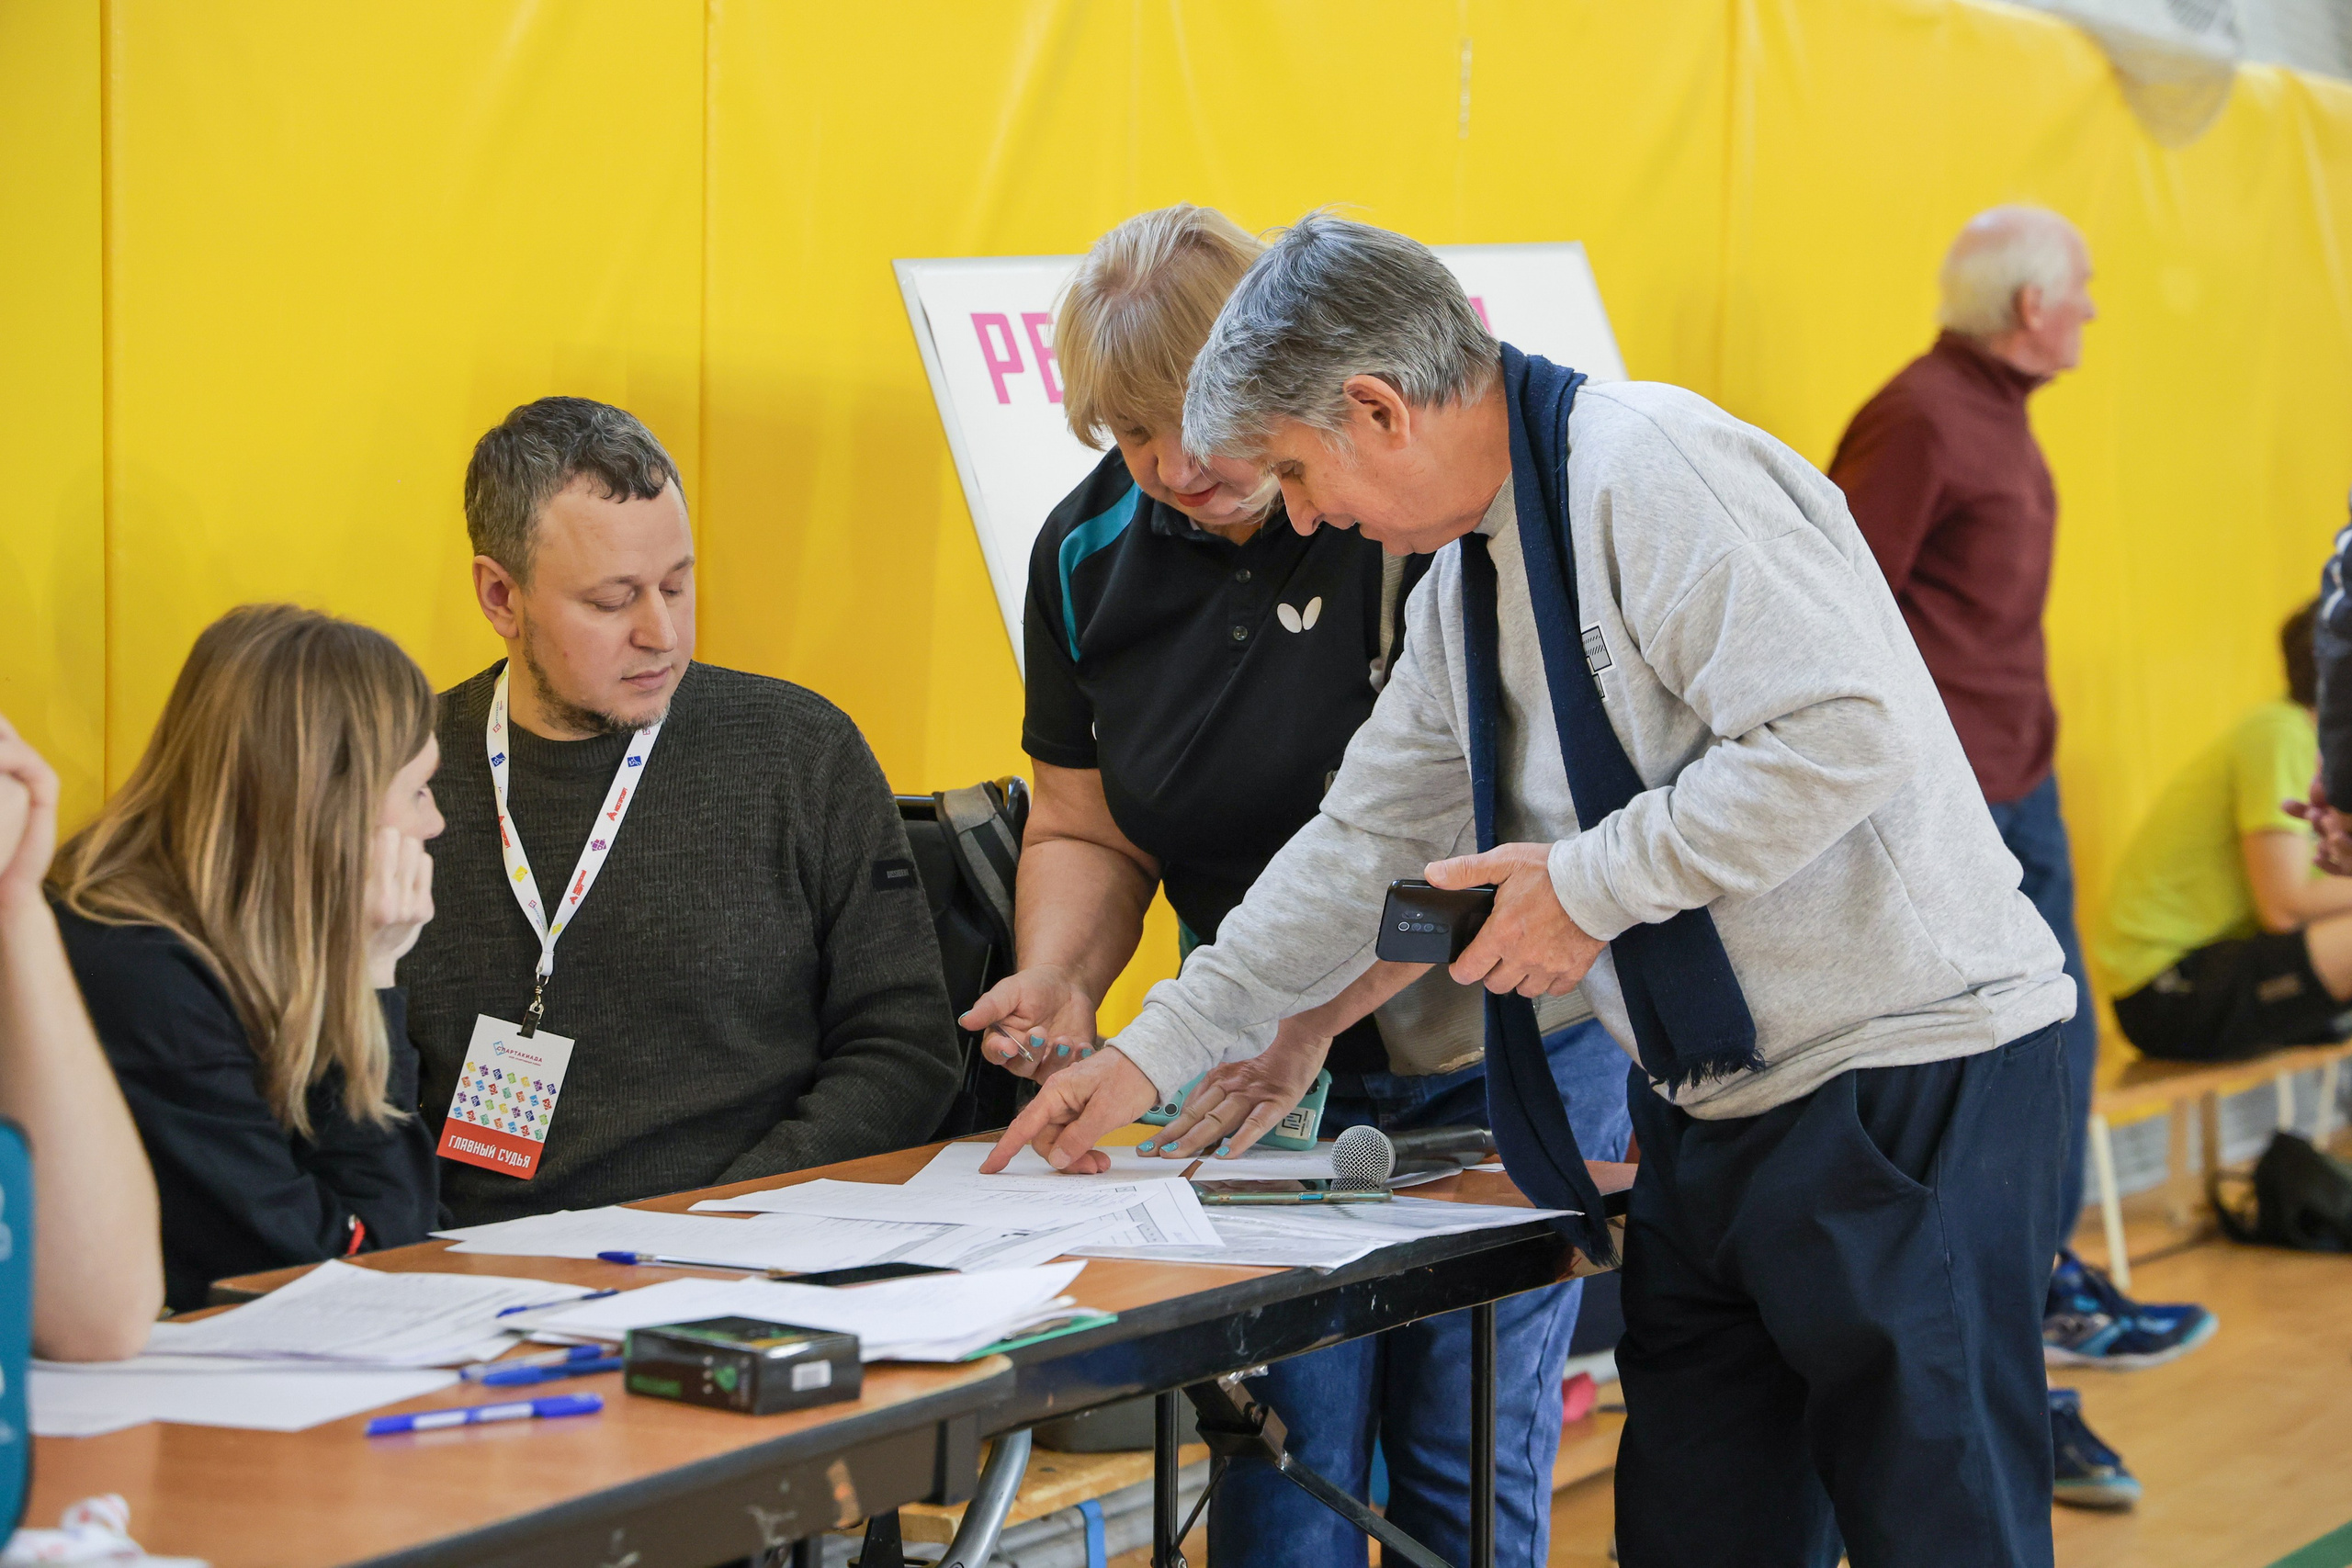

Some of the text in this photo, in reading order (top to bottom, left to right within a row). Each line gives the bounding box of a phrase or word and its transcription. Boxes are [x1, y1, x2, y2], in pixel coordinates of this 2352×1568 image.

[496, 1045, 543, 1063] СПАРТАКИАДА
[447, 1134, 531, 1168] ГЛАВНЫЙ СУДЬЯ
